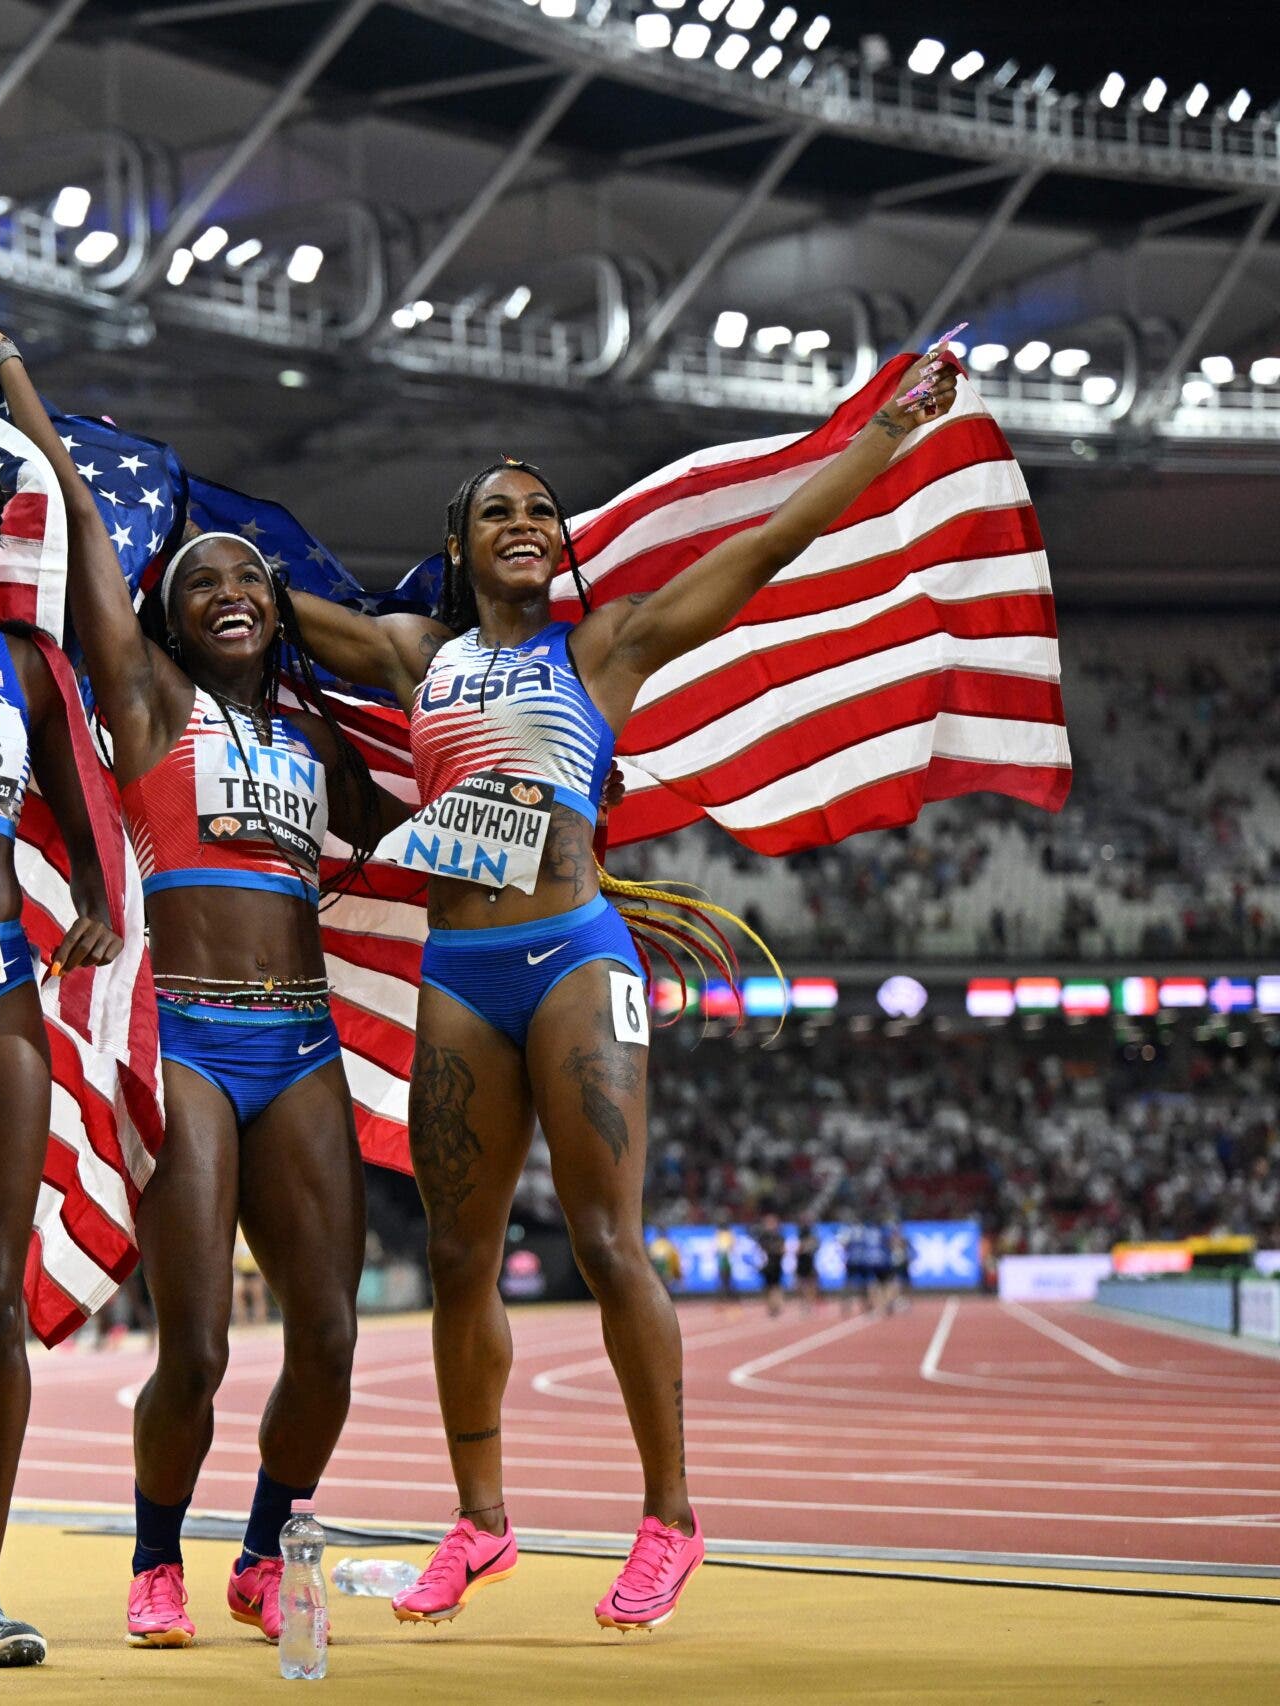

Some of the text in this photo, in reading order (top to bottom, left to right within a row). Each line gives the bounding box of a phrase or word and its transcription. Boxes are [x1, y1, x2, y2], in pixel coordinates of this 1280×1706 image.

[421, 662, 553, 713] USA
[0, 785, 11, 798] 23
[226, 740, 316, 794] NTN
[457, 777, 505, 794] BUDA
[219, 778, 318, 830] TERRY
[403, 829, 508, 885] NTN
[625, 984, 641, 1033] 6
